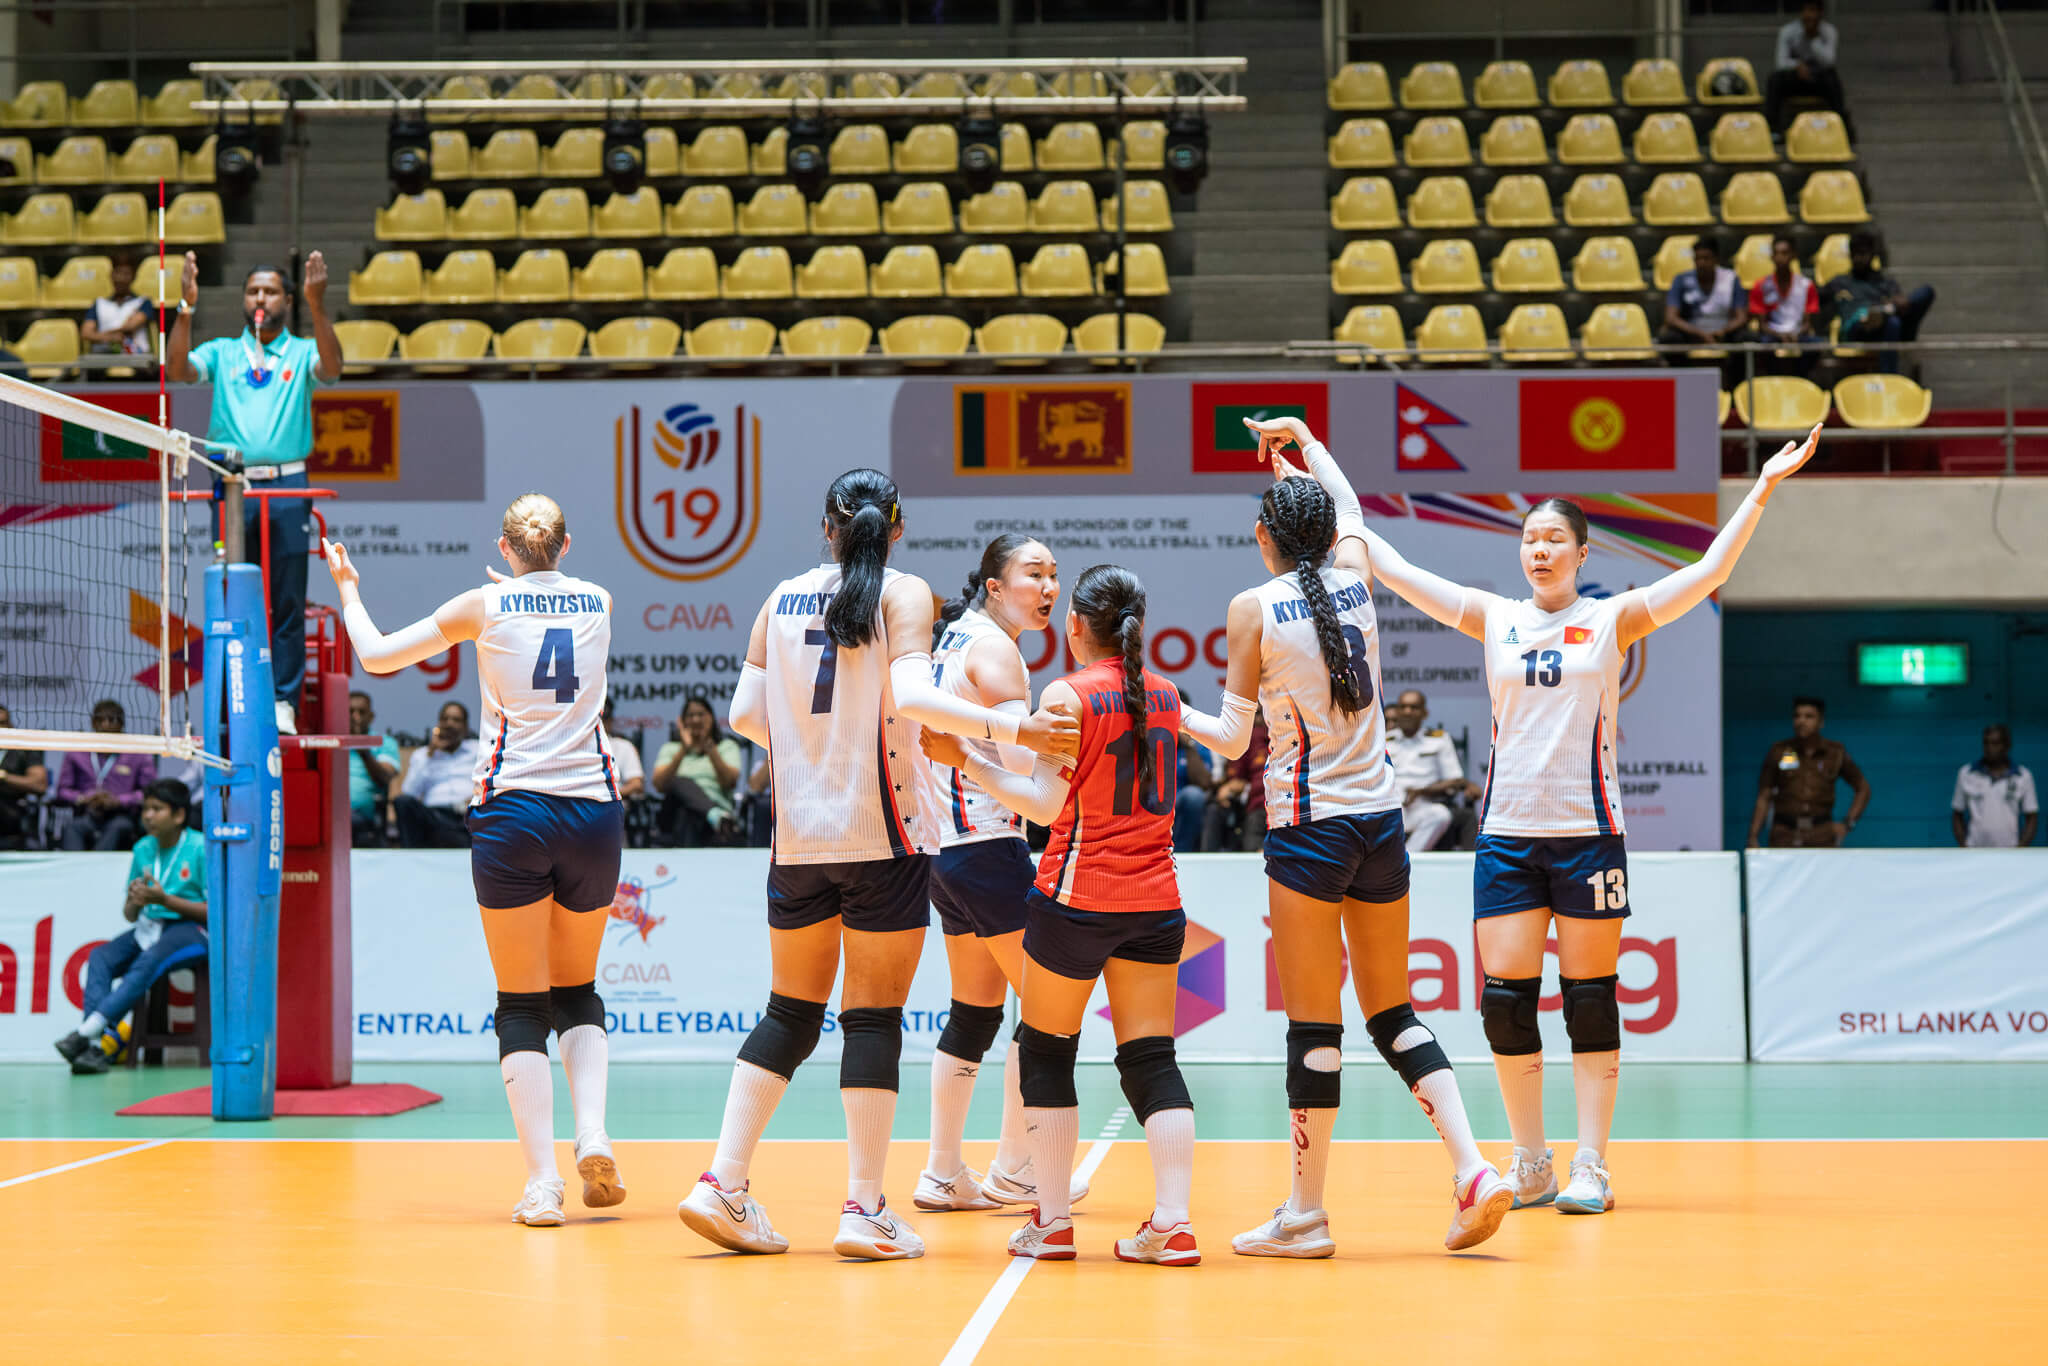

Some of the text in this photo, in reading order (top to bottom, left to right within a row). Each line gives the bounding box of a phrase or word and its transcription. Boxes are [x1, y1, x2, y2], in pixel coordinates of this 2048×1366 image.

[653, 488, 722, 540] 19
[974, 518, 1190, 531] OFFICIAL SPONSOR OF THE
[1108, 536, 1210, 549] VOLLEYBALL
[500, 593, 605, 614] KYRGYZSTAN
[643, 603, 735, 632] CAVA
[532, 628, 580, 704] 4
[651, 655, 689, 673] U19
[803, 628, 839, 715] 7
[1520, 649, 1563, 688] 13
[1105, 726, 1177, 817] 10
[269, 789, 281, 871] senoh
[1587, 868, 1627, 912] 13
[602, 962, 672, 984] CAVA
[352, 1012, 472, 1035] ENTRAL
[1839, 1012, 1887, 1033] SRI
[1897, 1012, 2000, 1033] LANKA
